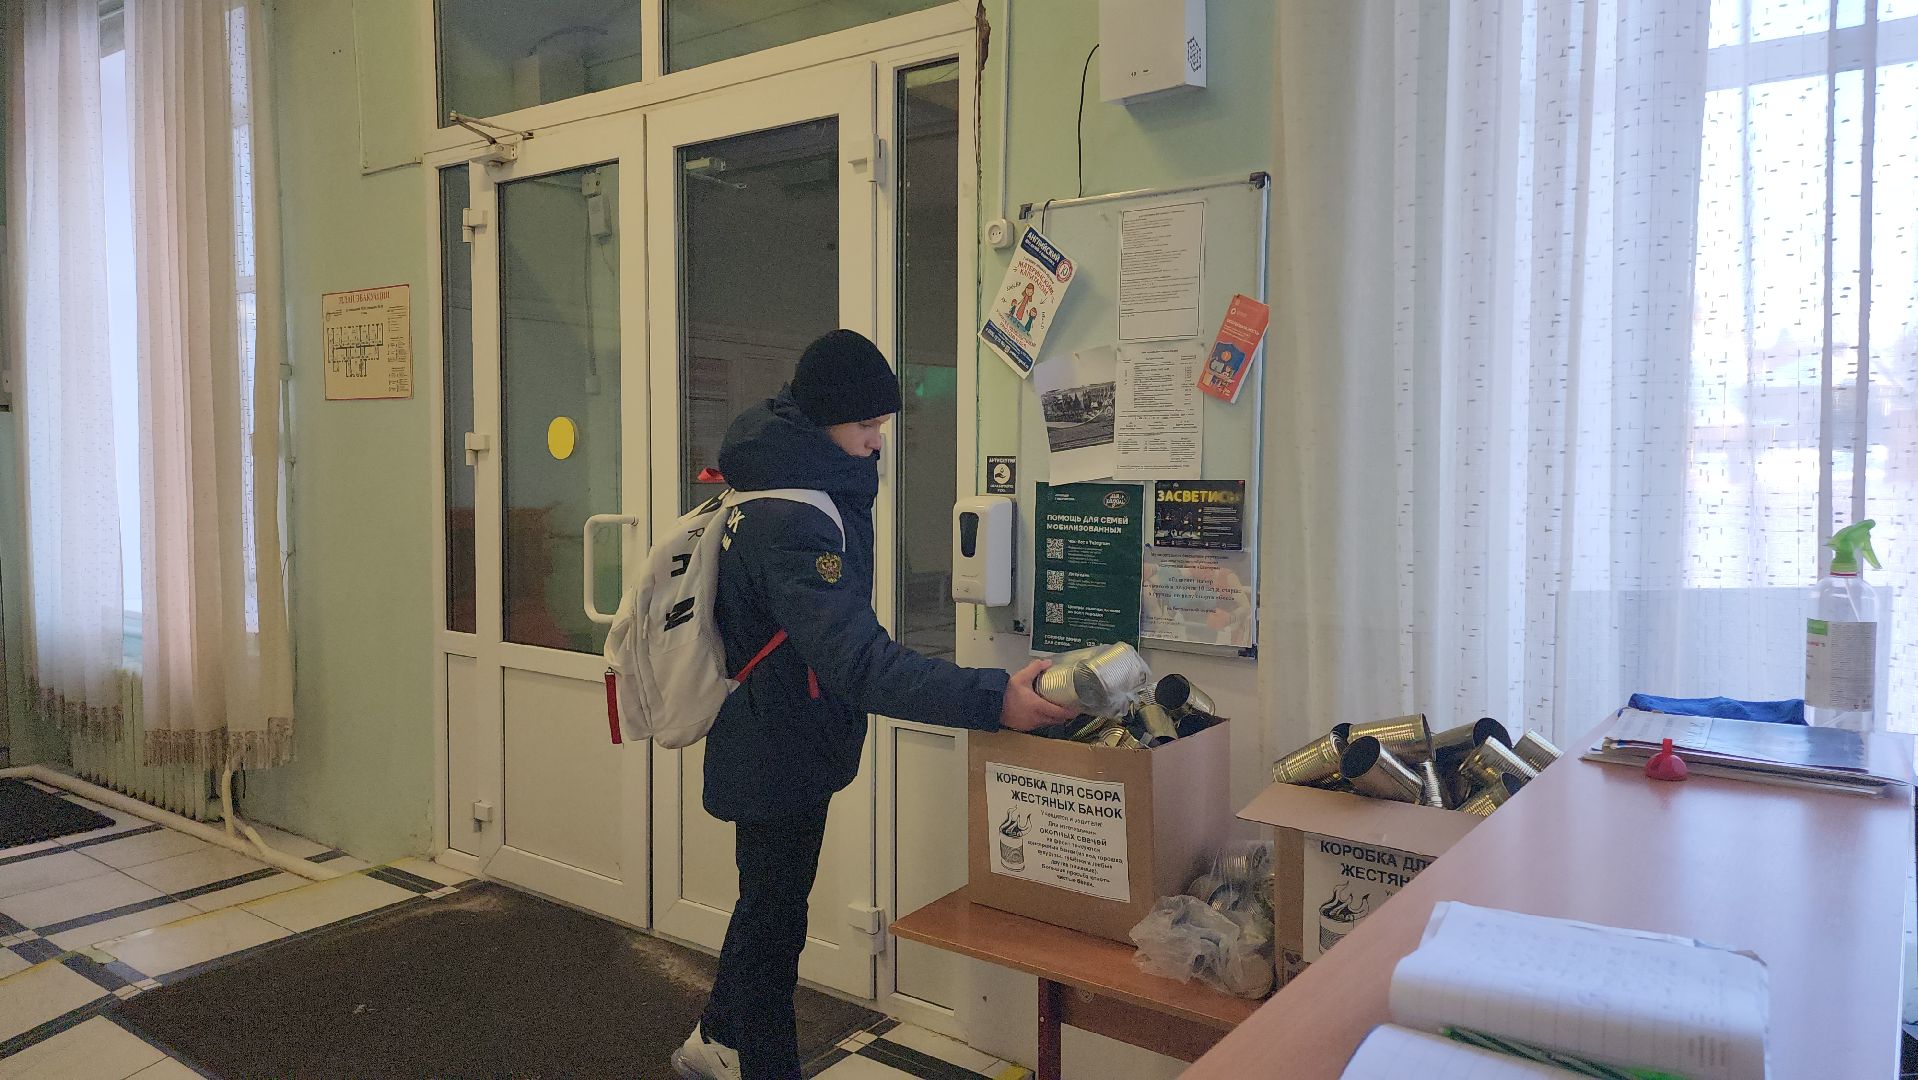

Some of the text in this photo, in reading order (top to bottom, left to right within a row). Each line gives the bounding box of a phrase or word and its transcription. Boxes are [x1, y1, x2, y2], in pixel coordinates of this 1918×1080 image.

[1046, 514, 1128, 525] ПОМОЩЬ ДЛЯ СЕМЕЙ
[1046, 523, 1122, 534] МОБИЛИЗОВАННЫХ
[996, 772, 1122, 802] КОРОБКА ДЛЯ СБОРА
[1011, 790, 1123, 819] ЖЕСТЯНЫХ БАНОК
[1320, 840, 1432, 873] КОРОБКА ДЛ
